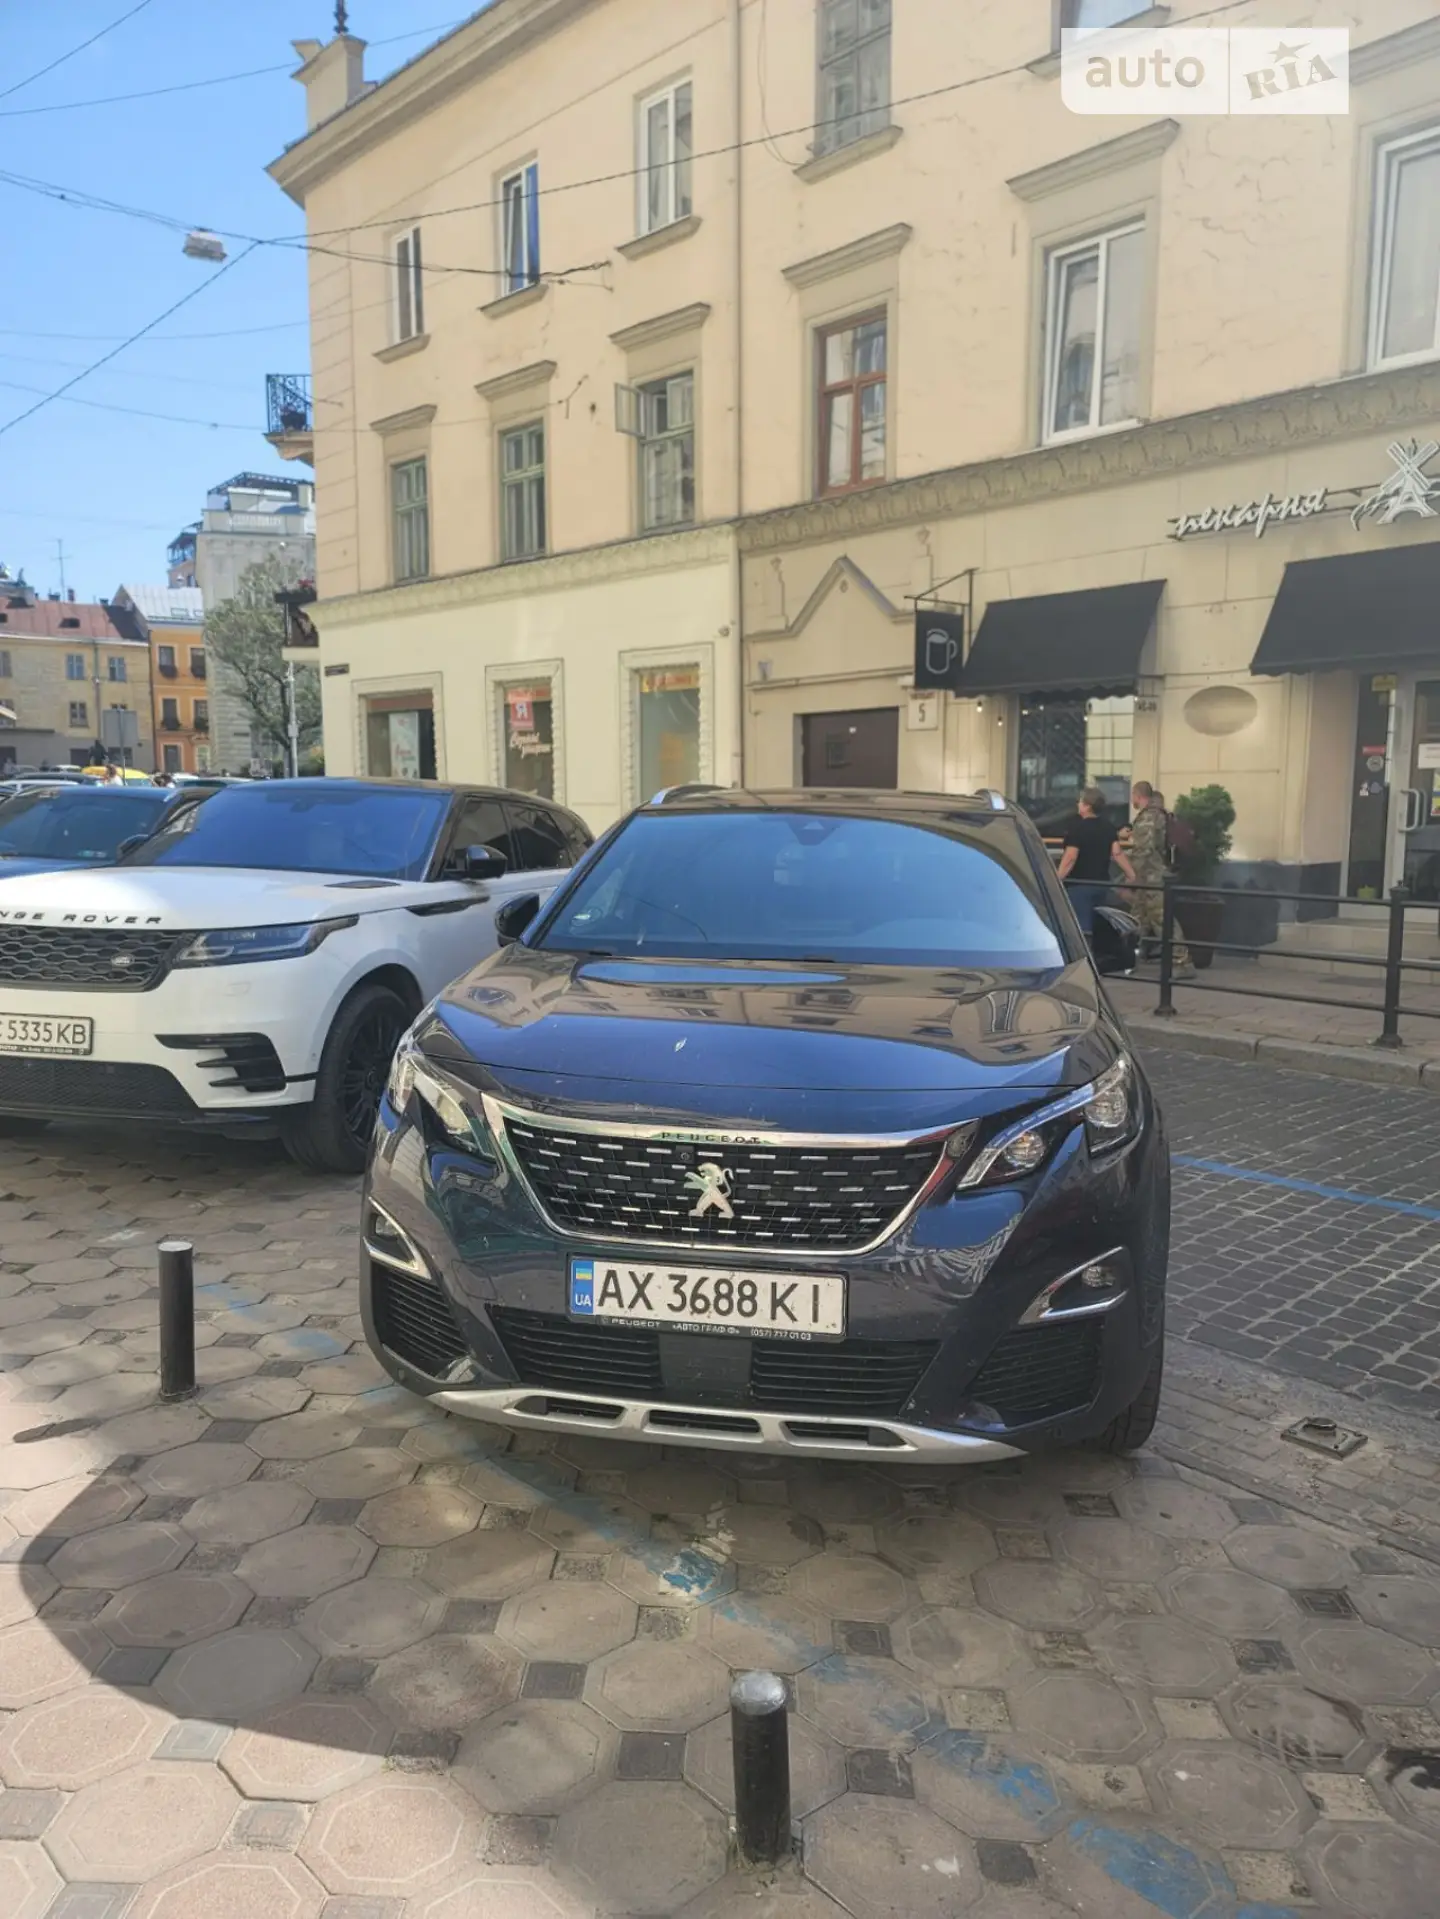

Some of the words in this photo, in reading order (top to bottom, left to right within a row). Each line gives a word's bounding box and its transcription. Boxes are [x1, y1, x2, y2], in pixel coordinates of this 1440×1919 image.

[1175, 487, 1328, 539] пекарня
[918, 702, 926, 723] 5
[62, 913, 162, 925] ROVER
[7, 1019, 53, 1043] 5335
[56, 1023, 86, 1045] KB
[661, 1131, 761, 1145] PEUGEOT
[575, 1293, 592, 1307] UA
[598, 1269, 654, 1311] AX
[666, 1273, 758, 1318] 3688
